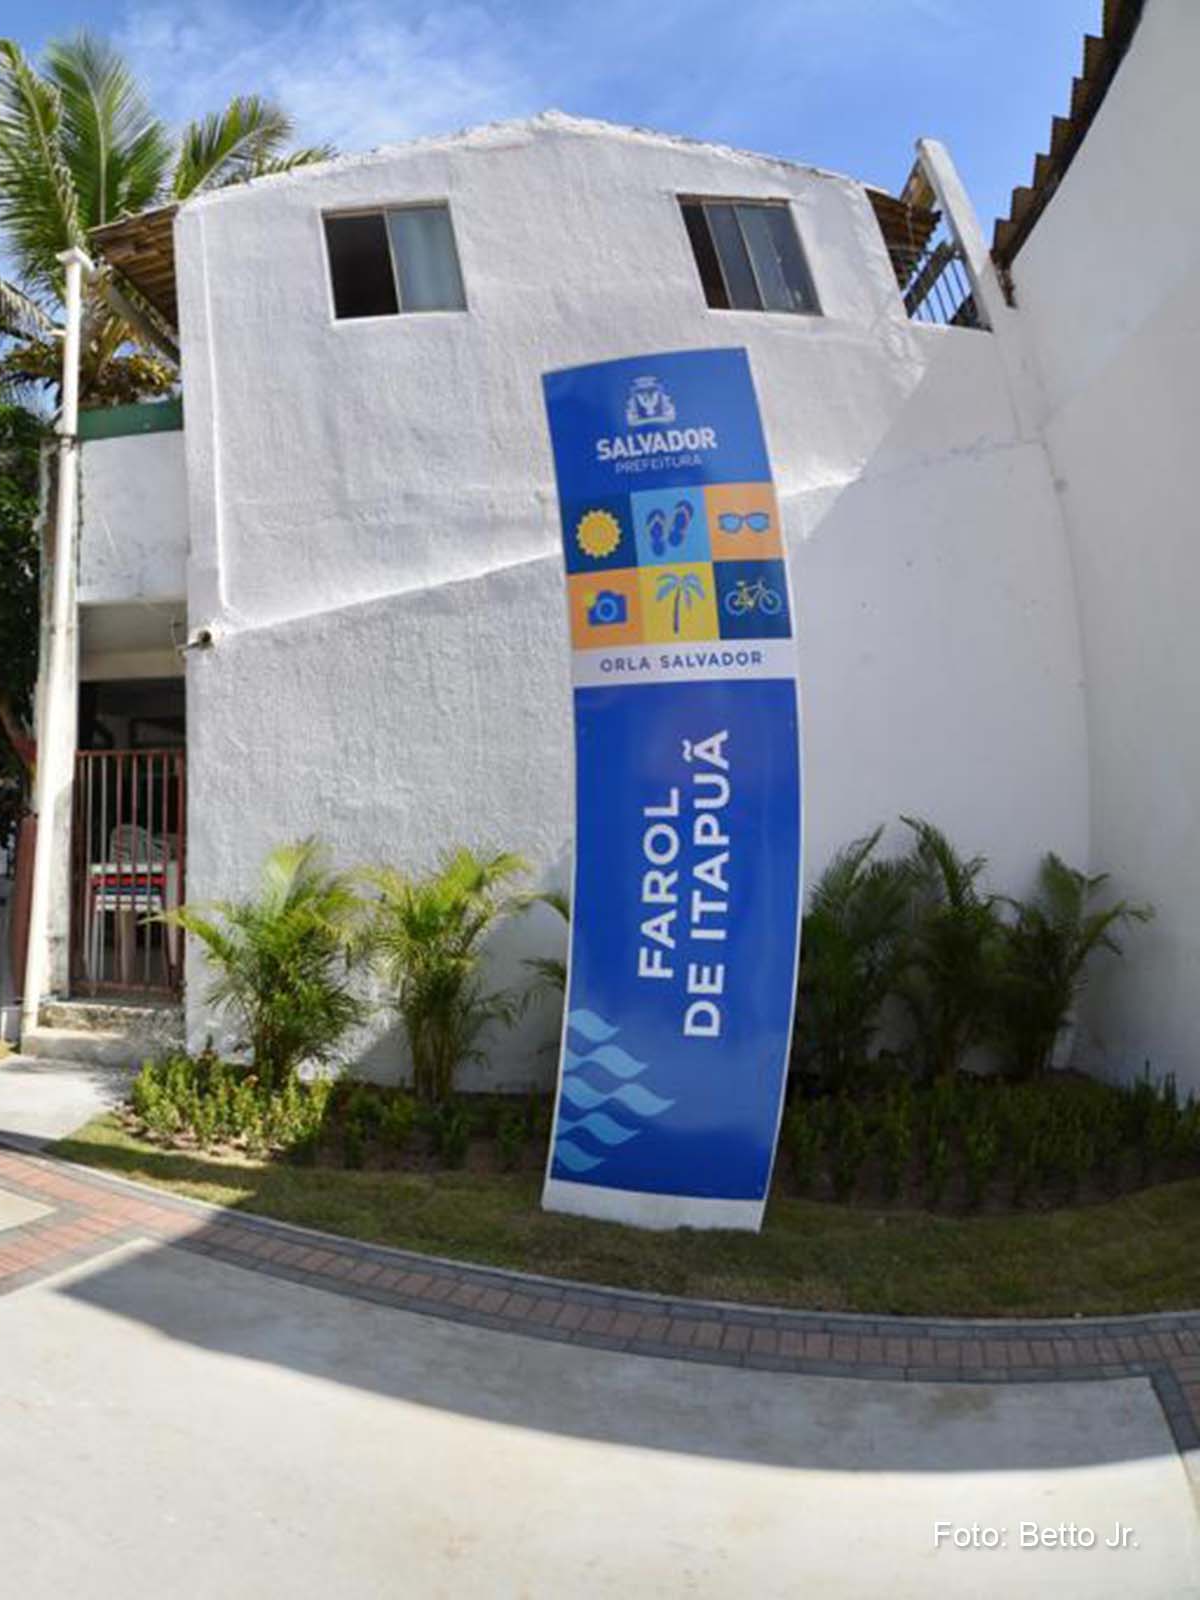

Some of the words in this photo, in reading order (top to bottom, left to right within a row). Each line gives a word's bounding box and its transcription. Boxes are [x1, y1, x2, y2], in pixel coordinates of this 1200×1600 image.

[596, 427, 717, 461] SALVADOR
[615, 454, 703, 474] PREFEITURA
[599, 654, 651, 673] ORLA
[660, 650, 763, 670] SALVADOR
[683, 730, 730, 941] ITAPUÃ
[638, 788, 680, 980] FAROL
[683, 963, 726, 1037] DE
